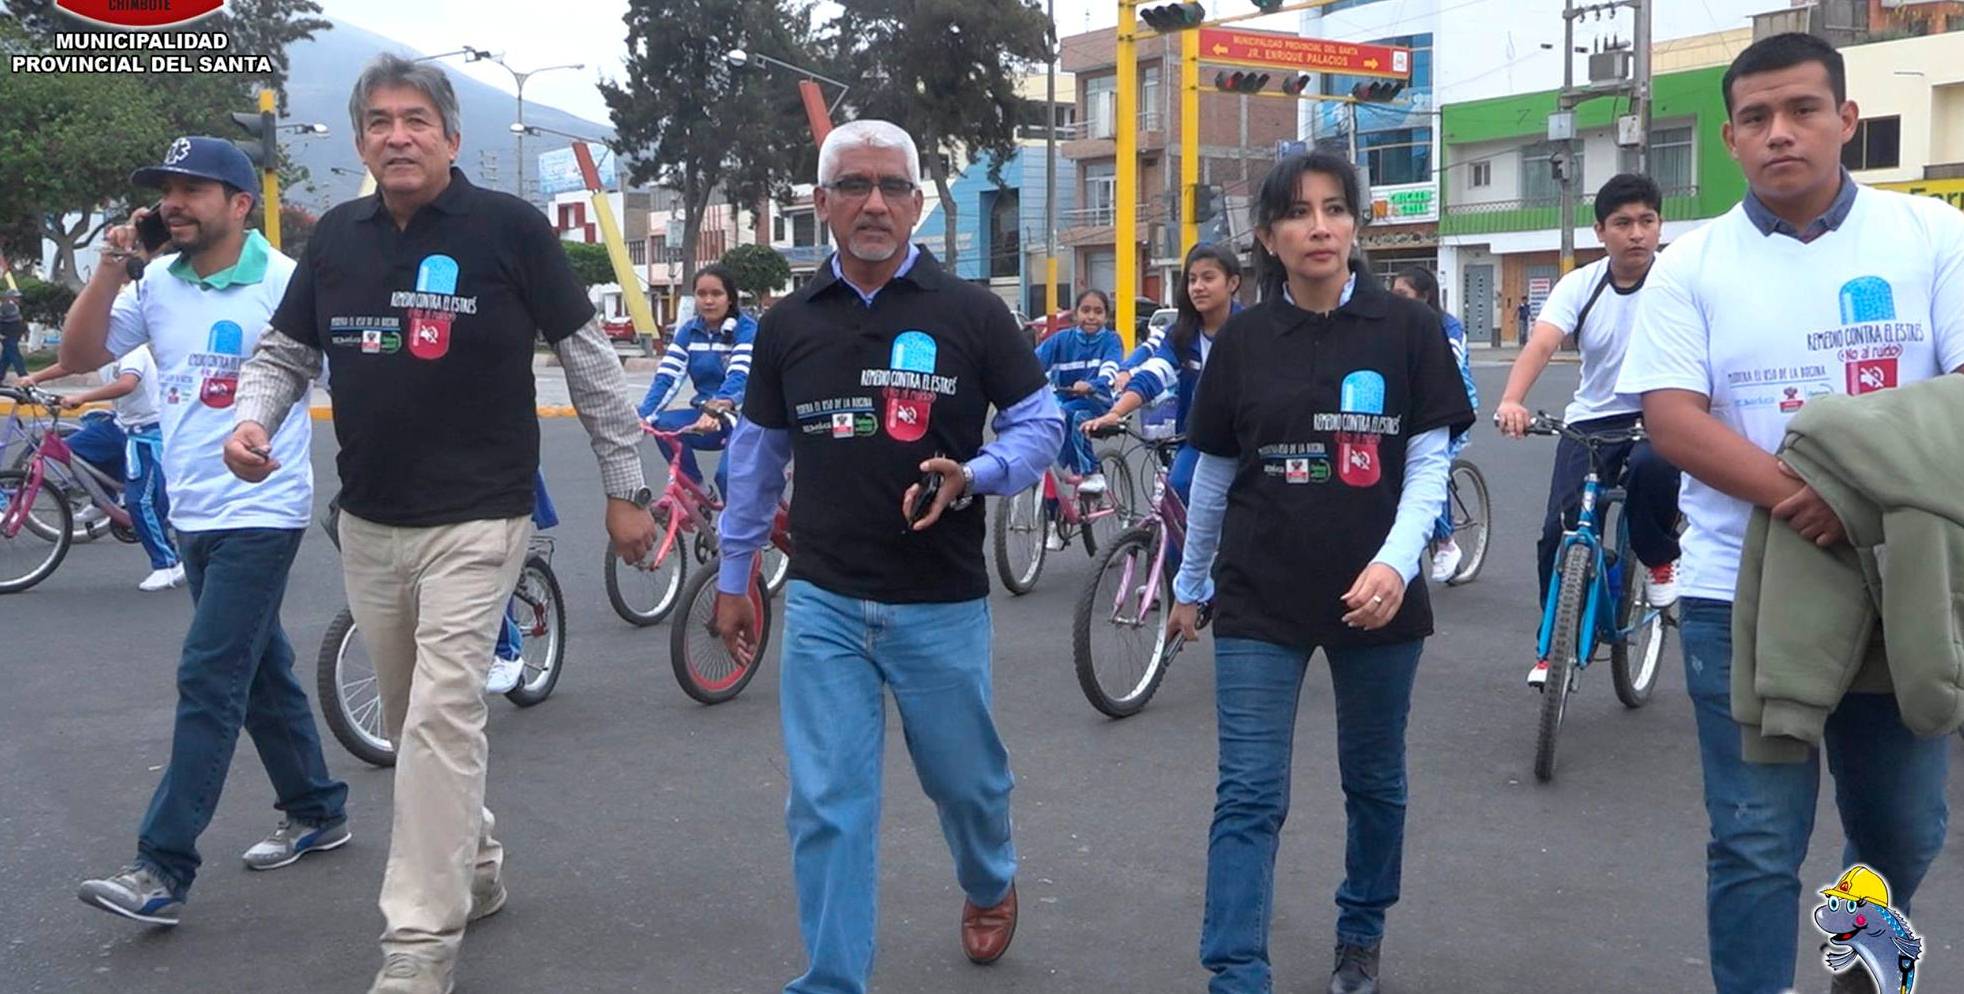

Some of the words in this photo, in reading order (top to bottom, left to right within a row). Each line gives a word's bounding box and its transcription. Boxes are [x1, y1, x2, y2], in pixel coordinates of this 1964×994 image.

[1233, 35, 1283, 49] MUNICIPALIDAD
[1285, 40, 1322, 52] PROVINCIAL
[1324, 45, 1336, 54] DEL
[1339, 46, 1358, 56] SANTA
[1247, 48, 1261, 58] JR.
[1265, 49, 1303, 63] ENRIQUE
[1306, 53, 1348, 66] PALACIOS
[416, 293, 442, 309] CONTRA
[1807, 328, 1843, 351] REMEDIO
[1845, 325, 1882, 347] CONTRA
[1884, 323, 1894, 342] EL
[890, 371, 920, 389] CONTRA
[922, 374, 930, 390] EL
[930, 374, 958, 395] ESTRÉS
